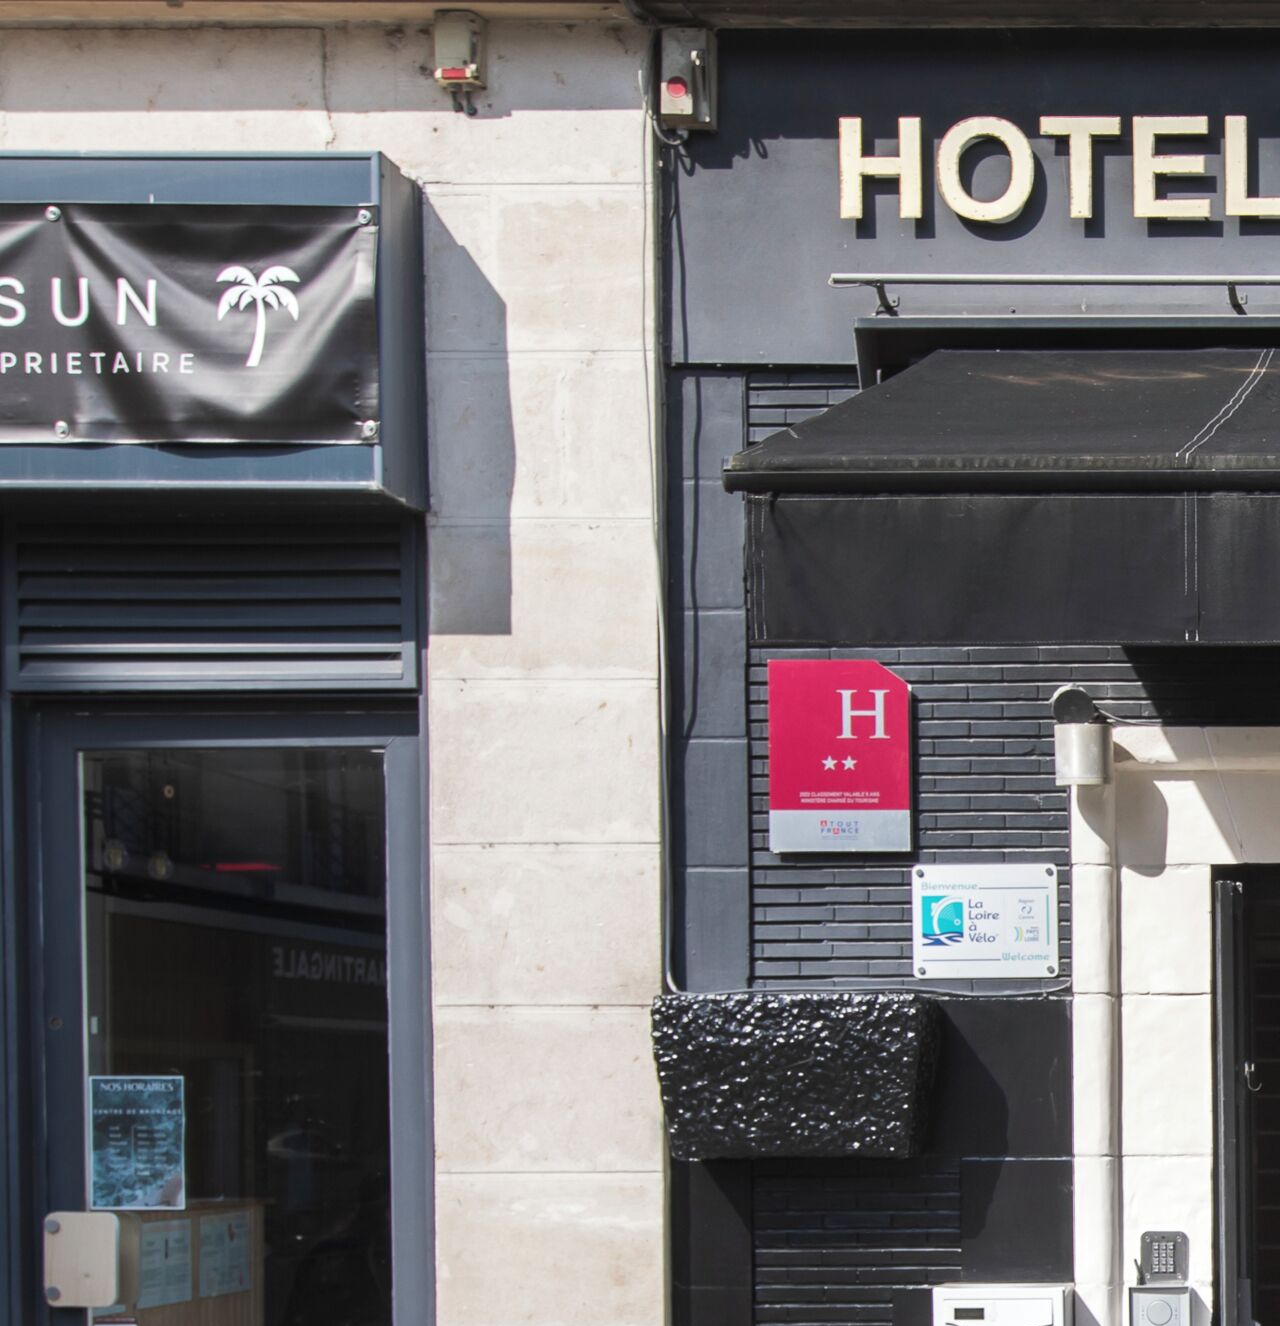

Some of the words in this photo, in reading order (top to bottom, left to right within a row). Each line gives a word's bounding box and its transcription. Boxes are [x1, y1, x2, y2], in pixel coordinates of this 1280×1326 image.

[0, 276, 157, 327] SUN
[0, 352, 195, 375] PRIETAIRE
[835, 688, 891, 740] H
[921, 882, 978, 890] Bienvenue
[968, 899, 983, 909] La
[968, 910, 1000, 920] Loire
[968, 921, 977, 932] à
[1001, 952, 1049, 961] Welcome
